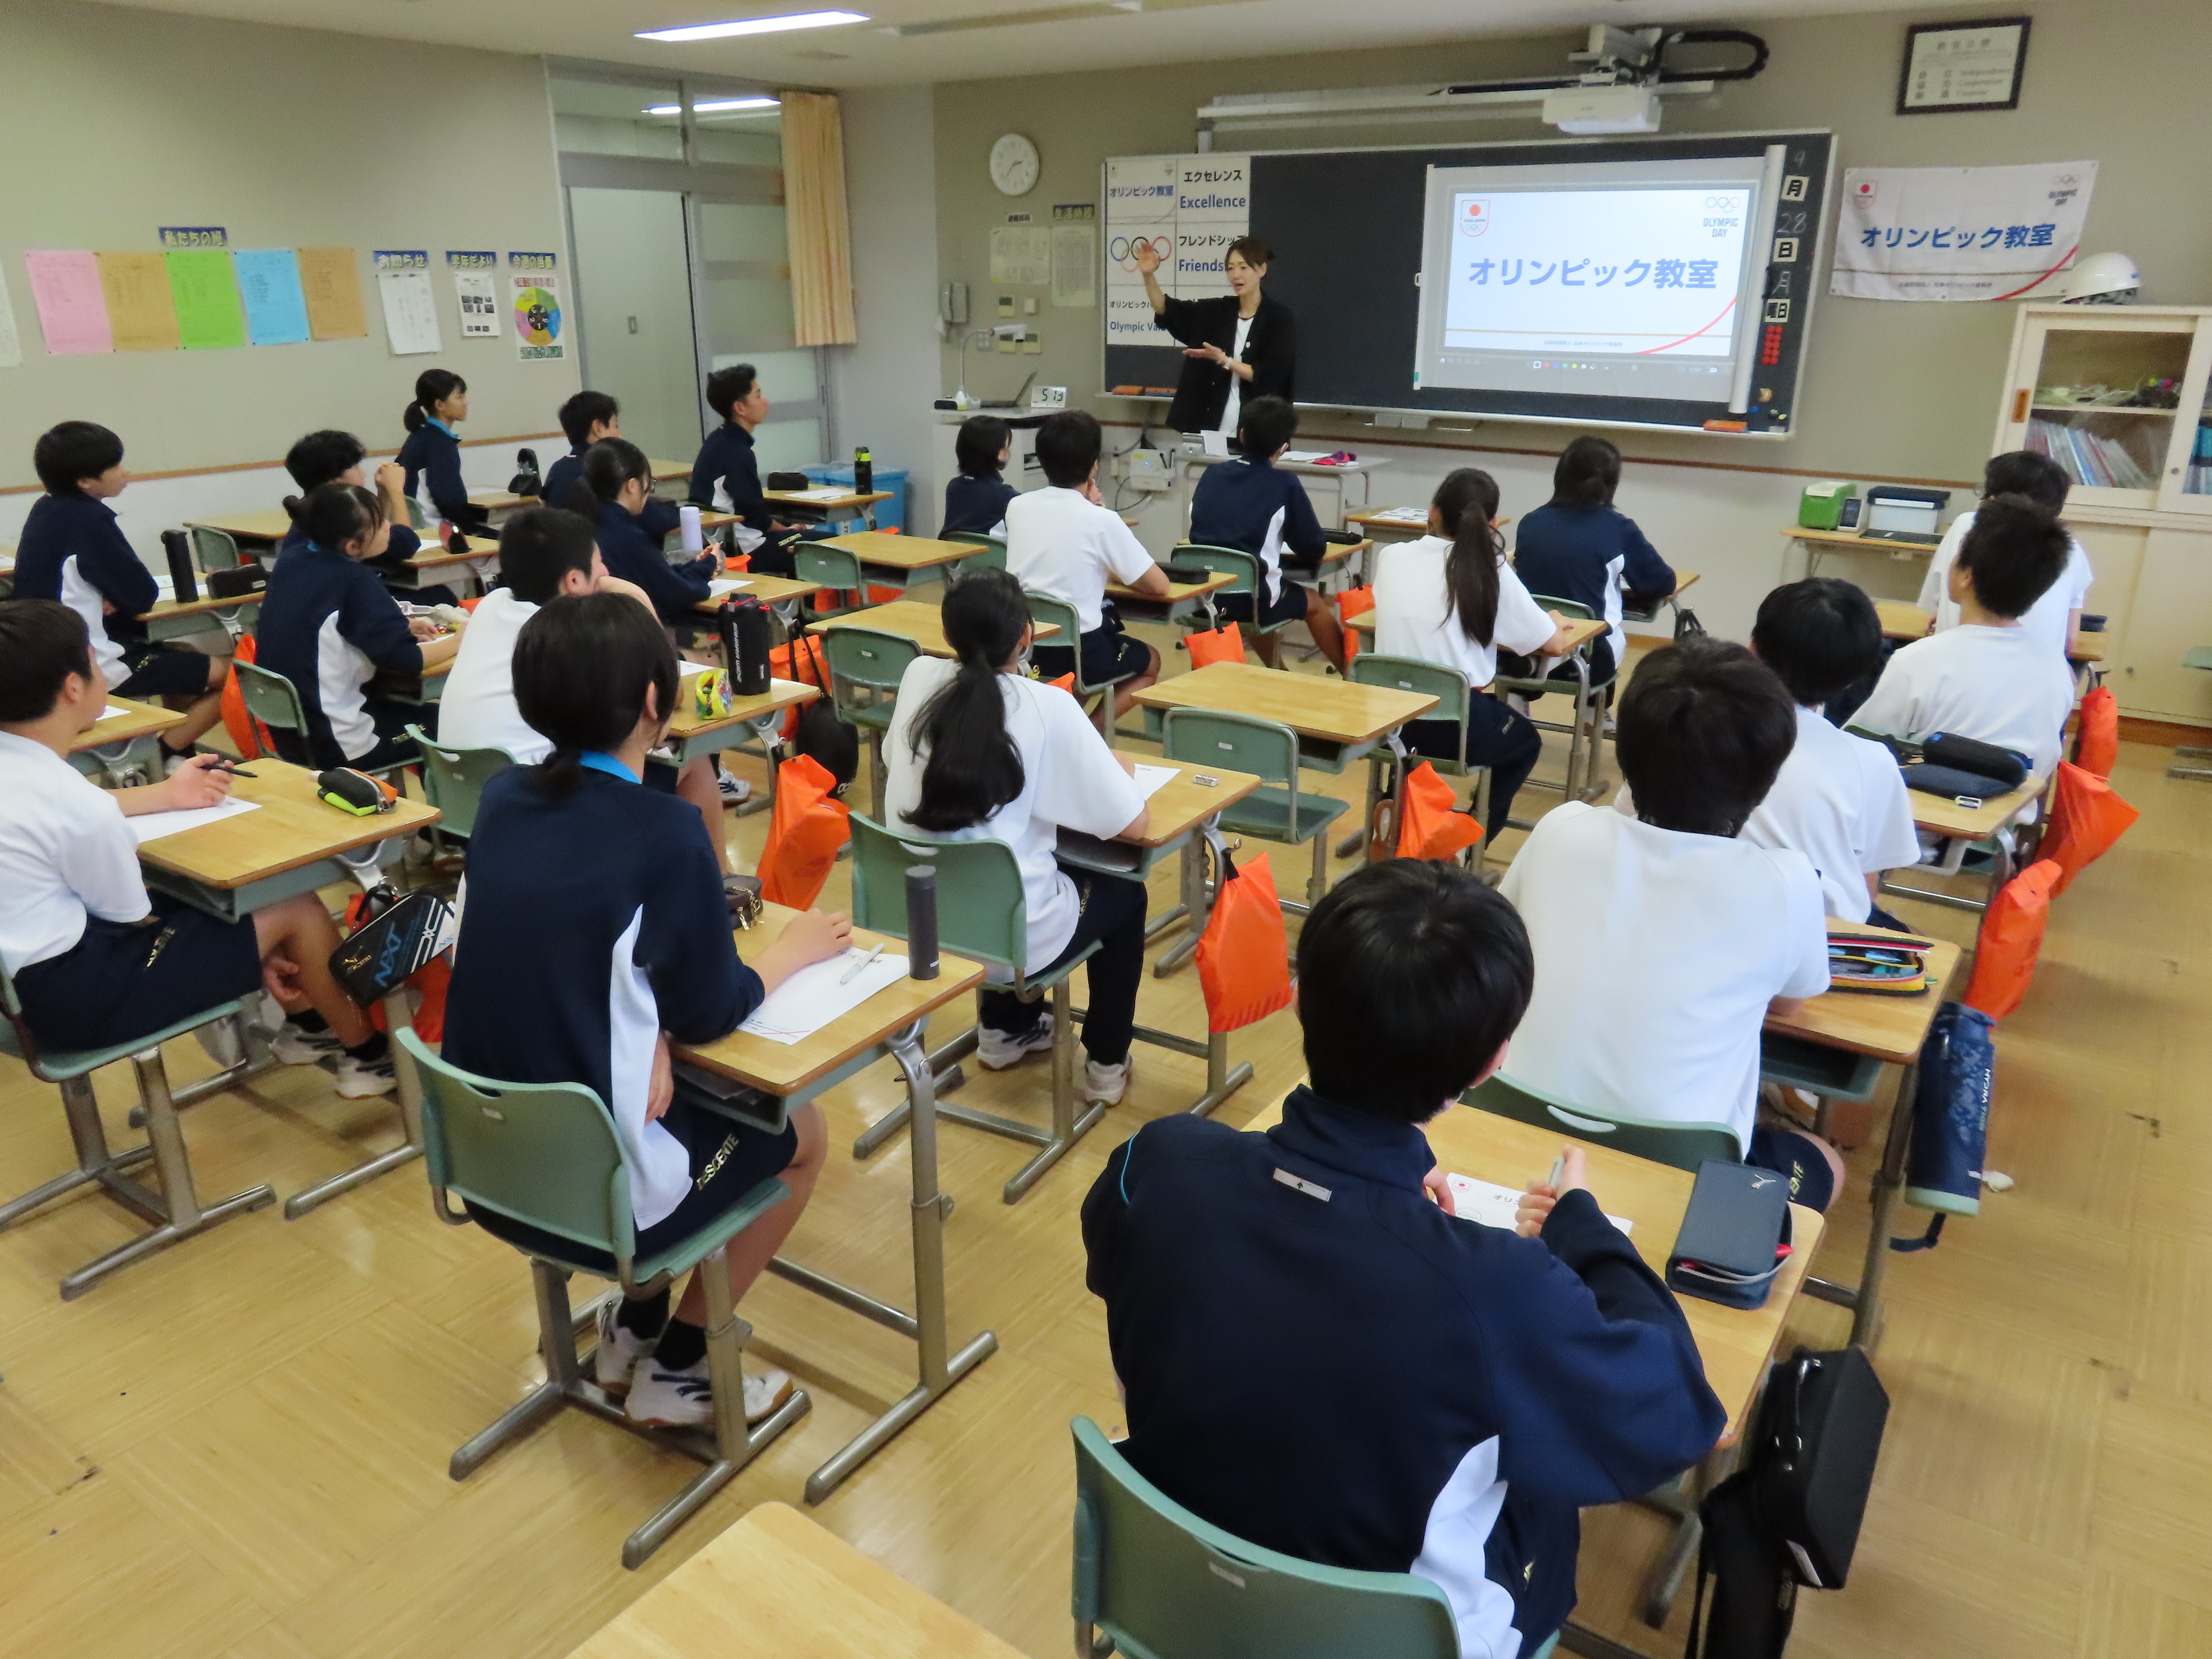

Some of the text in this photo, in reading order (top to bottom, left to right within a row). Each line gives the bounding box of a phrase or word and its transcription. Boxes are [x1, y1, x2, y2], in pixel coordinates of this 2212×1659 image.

[1184, 169, 1242, 183] エクセレンス
[1787, 179, 1802, 197] 月
[1180, 195, 1246, 209] Excellence
[1703, 217, 1739, 227] OLYMPIC
[1776, 213, 1807, 233] 28
[1711, 228, 1727, 238] DAY
[1860, 223, 2057, 249] オリンピック教室
[1778, 241, 1792, 258] 日
[378, 254, 426, 268] お知らせ
[1179, 259, 1226, 271] Friends
[1469, 258, 1719, 289] オリンピック教室
[1110, 321, 1144, 333] Olympic
